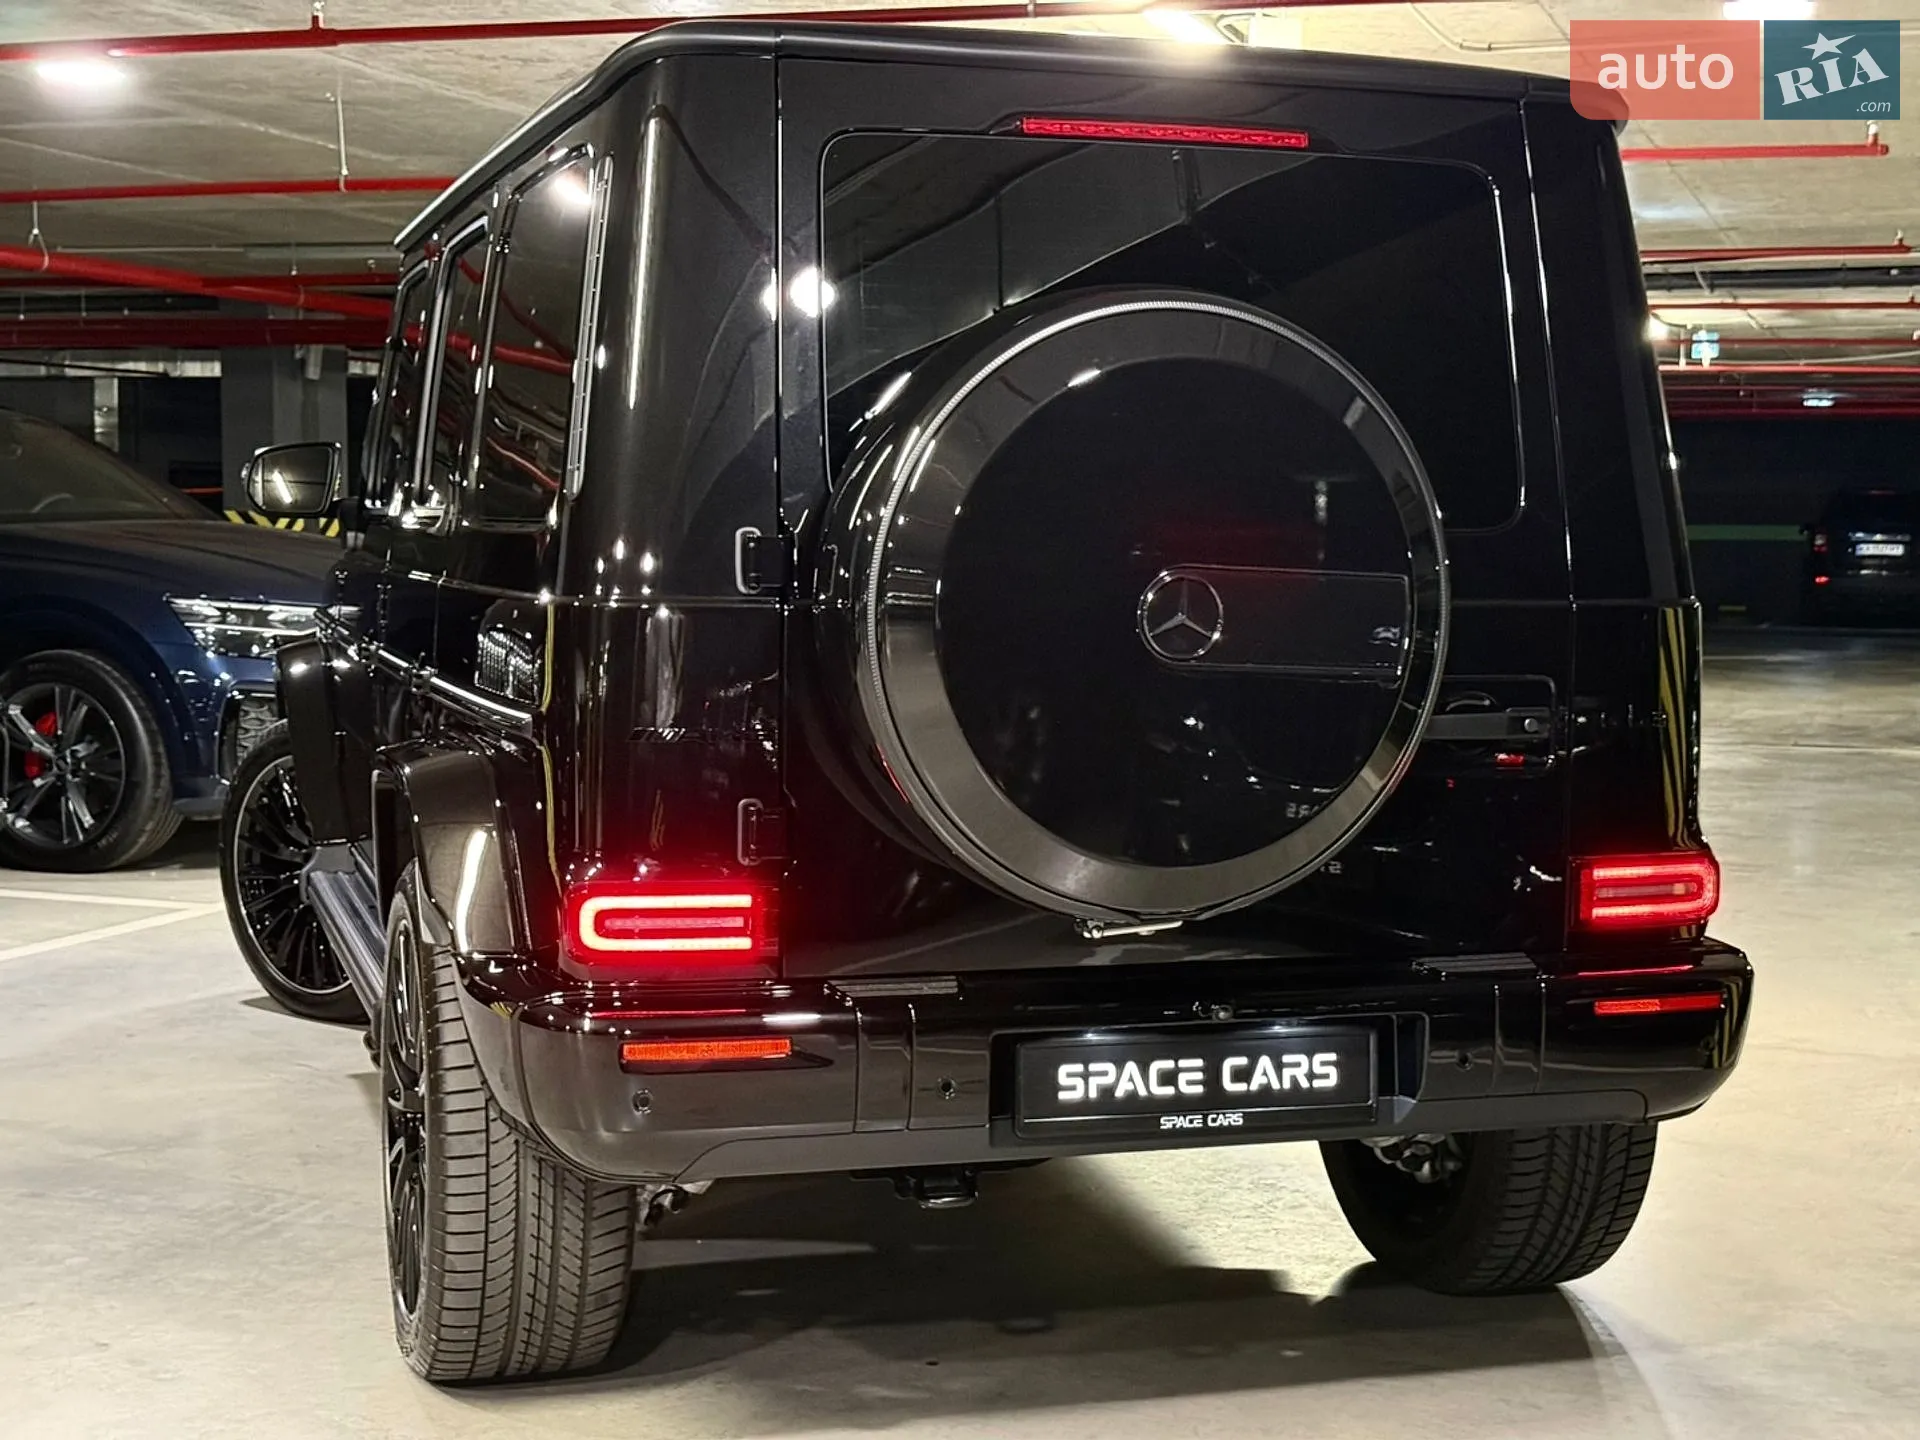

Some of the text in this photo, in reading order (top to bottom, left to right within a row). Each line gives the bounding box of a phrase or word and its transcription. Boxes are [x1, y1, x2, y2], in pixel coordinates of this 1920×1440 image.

[1057, 1051, 1340, 1102] SPACE CARS
[1159, 1112, 1244, 1130] SPACE CARS
